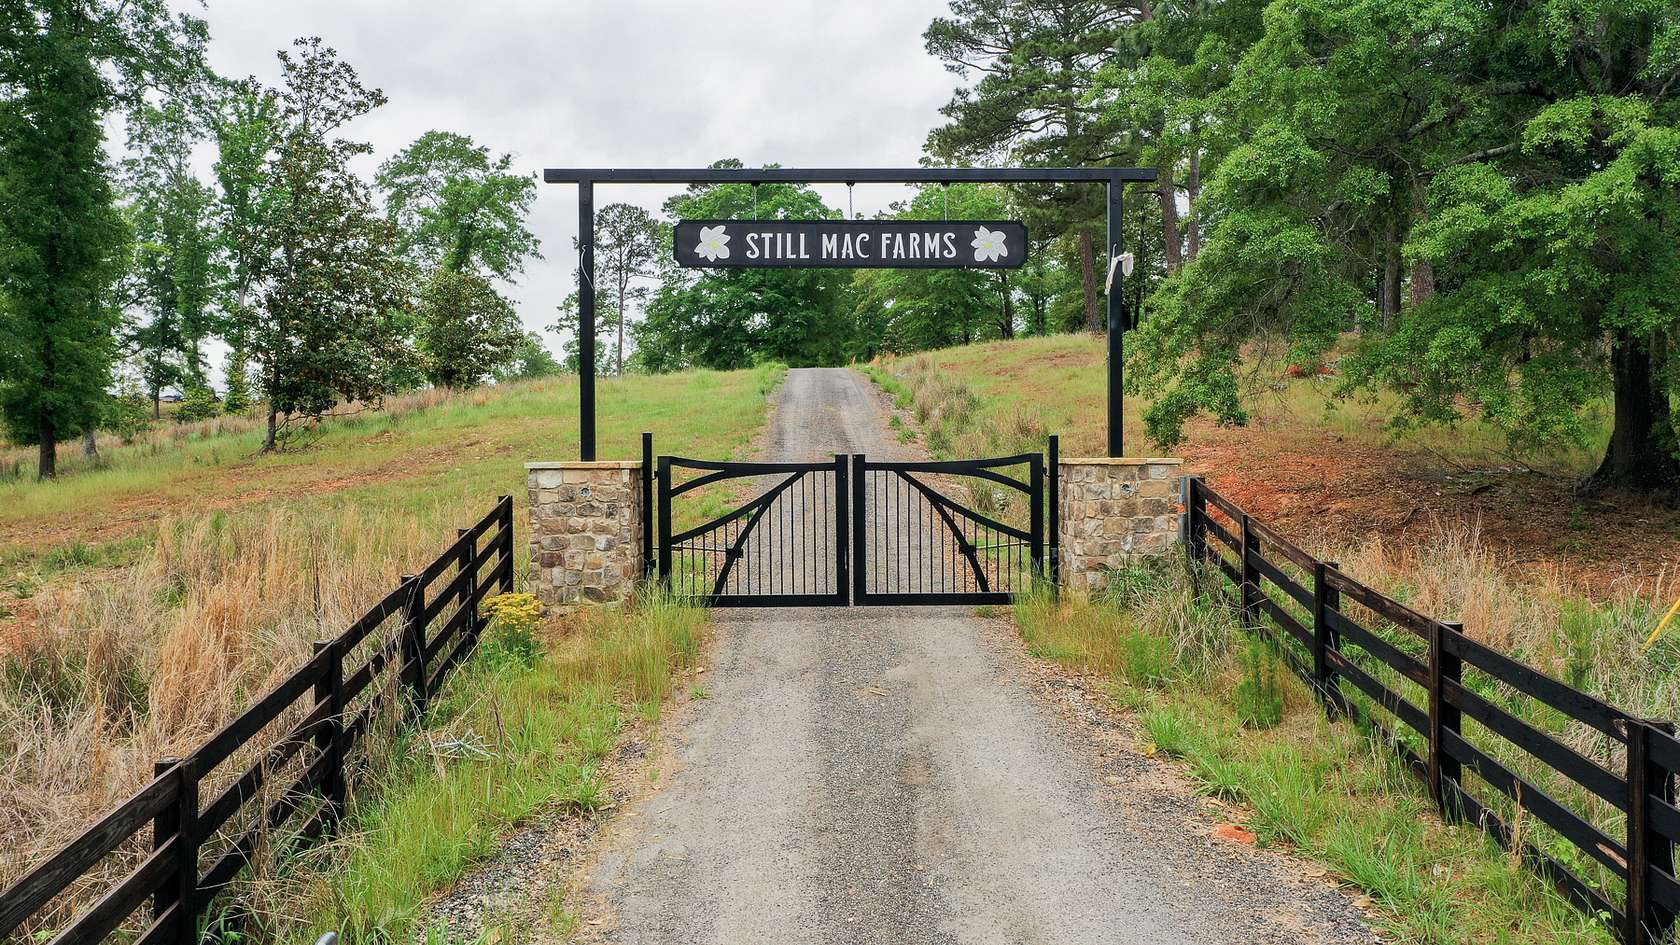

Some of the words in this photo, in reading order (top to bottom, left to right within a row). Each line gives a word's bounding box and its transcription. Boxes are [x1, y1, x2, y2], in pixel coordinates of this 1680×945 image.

[745, 232, 810, 259] STILL
[821, 232, 870, 259] MAC
[881, 232, 957, 259] FARMS
